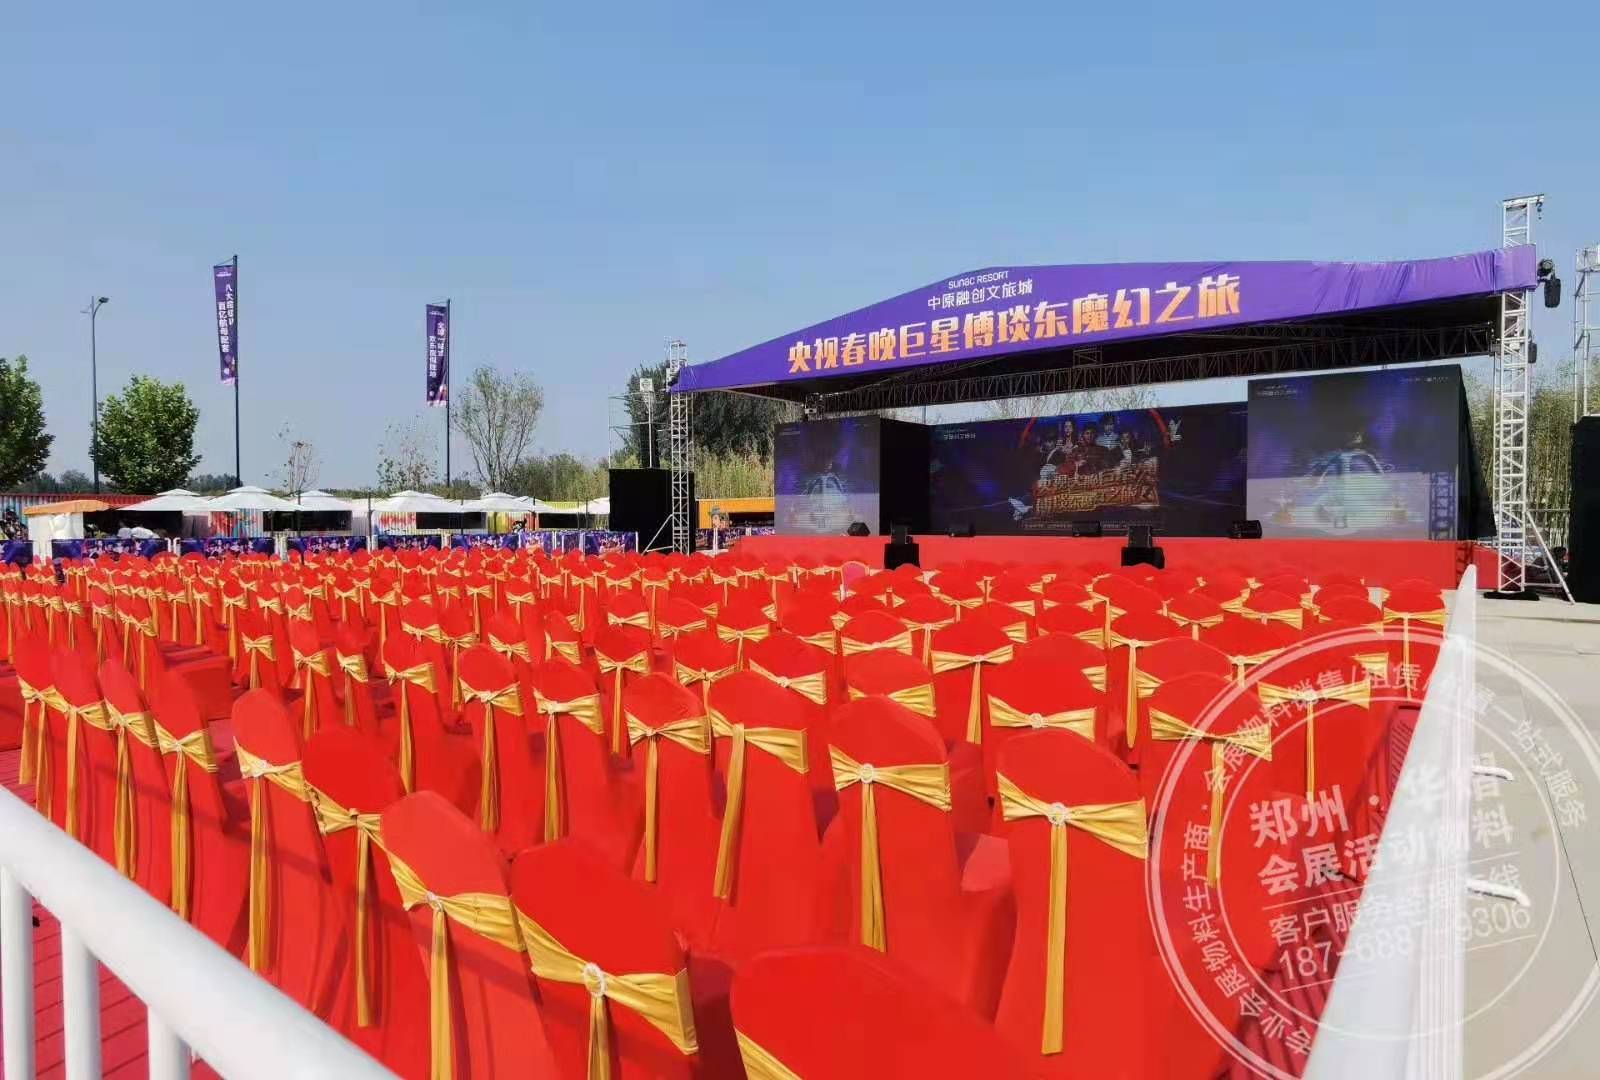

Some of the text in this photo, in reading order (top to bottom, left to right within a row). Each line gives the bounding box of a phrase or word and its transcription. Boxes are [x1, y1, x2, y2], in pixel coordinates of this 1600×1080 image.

[976, 270, 1010, 284] RESORT
[927, 278, 1034, 311] 中原融创文旅城
[787, 273, 1241, 374] 央视春晚巨星傅琰东魔幻之旅
